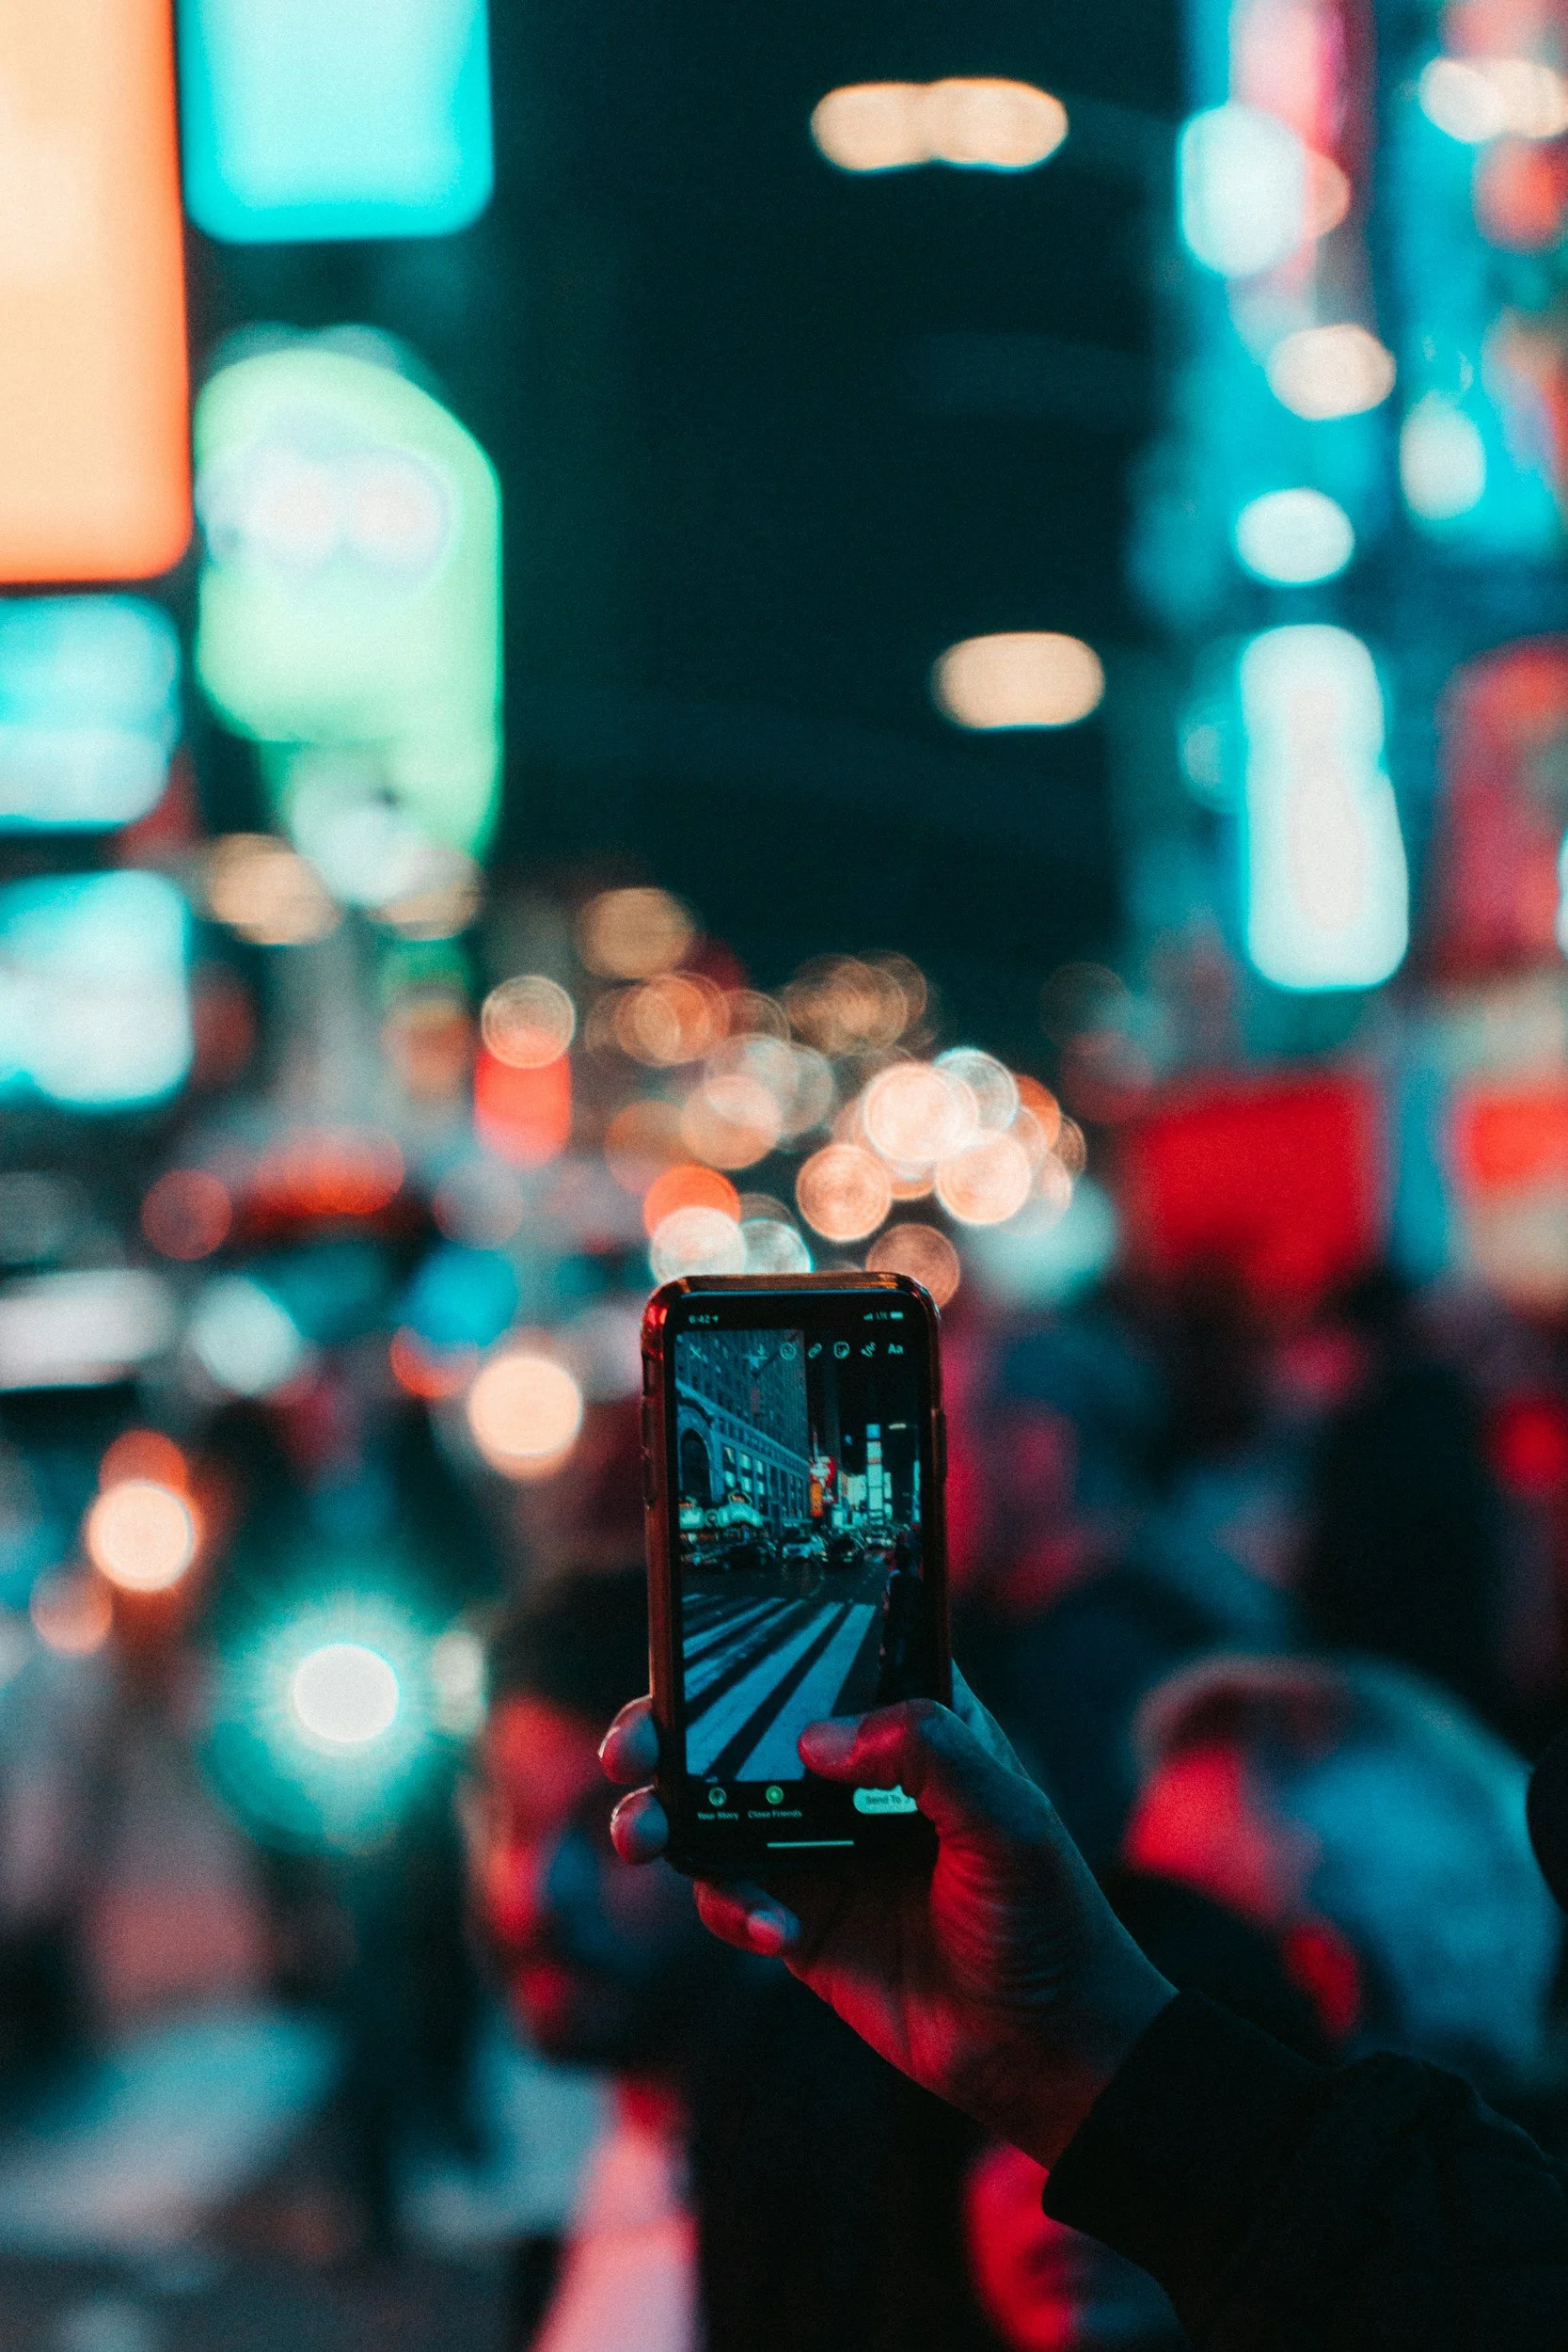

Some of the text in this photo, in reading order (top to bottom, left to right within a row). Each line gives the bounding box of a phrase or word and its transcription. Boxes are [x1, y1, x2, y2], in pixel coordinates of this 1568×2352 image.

[888, 1343, 904, 1355] Aa
[865, 1795, 901, 1804] Send To
[698, 1811, 739, 1820] Your Story
[748, 1809, 802, 1819] Close Friends
